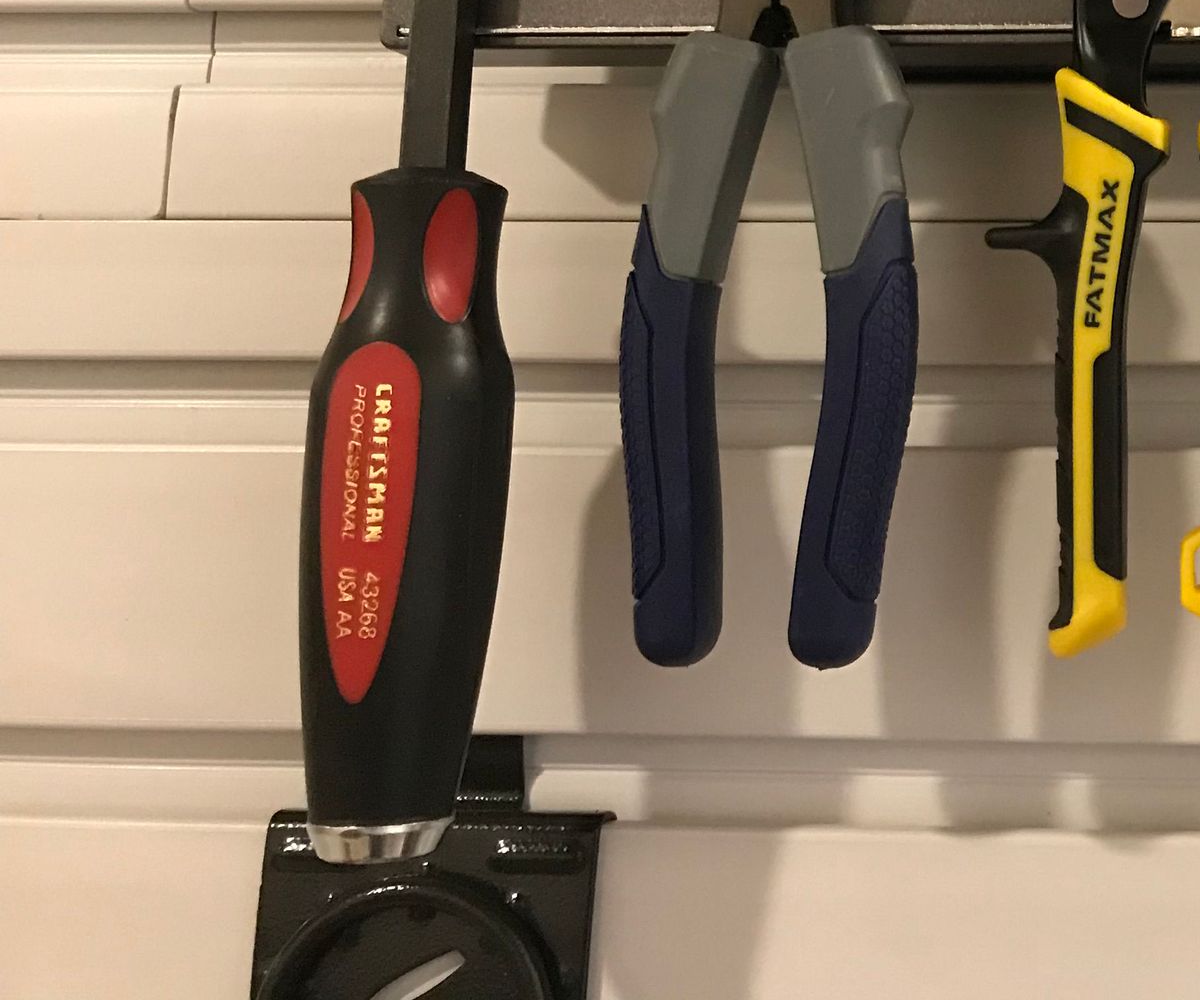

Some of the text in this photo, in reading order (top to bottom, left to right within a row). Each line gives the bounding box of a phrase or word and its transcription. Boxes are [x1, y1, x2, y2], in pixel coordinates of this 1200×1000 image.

[1084, 179, 1121, 329] FATMAX
[340, 384, 367, 542] PROFESSIONAL
[358, 383, 393, 639] CRAFTSMAN 43268
[337, 567, 358, 602] USA
